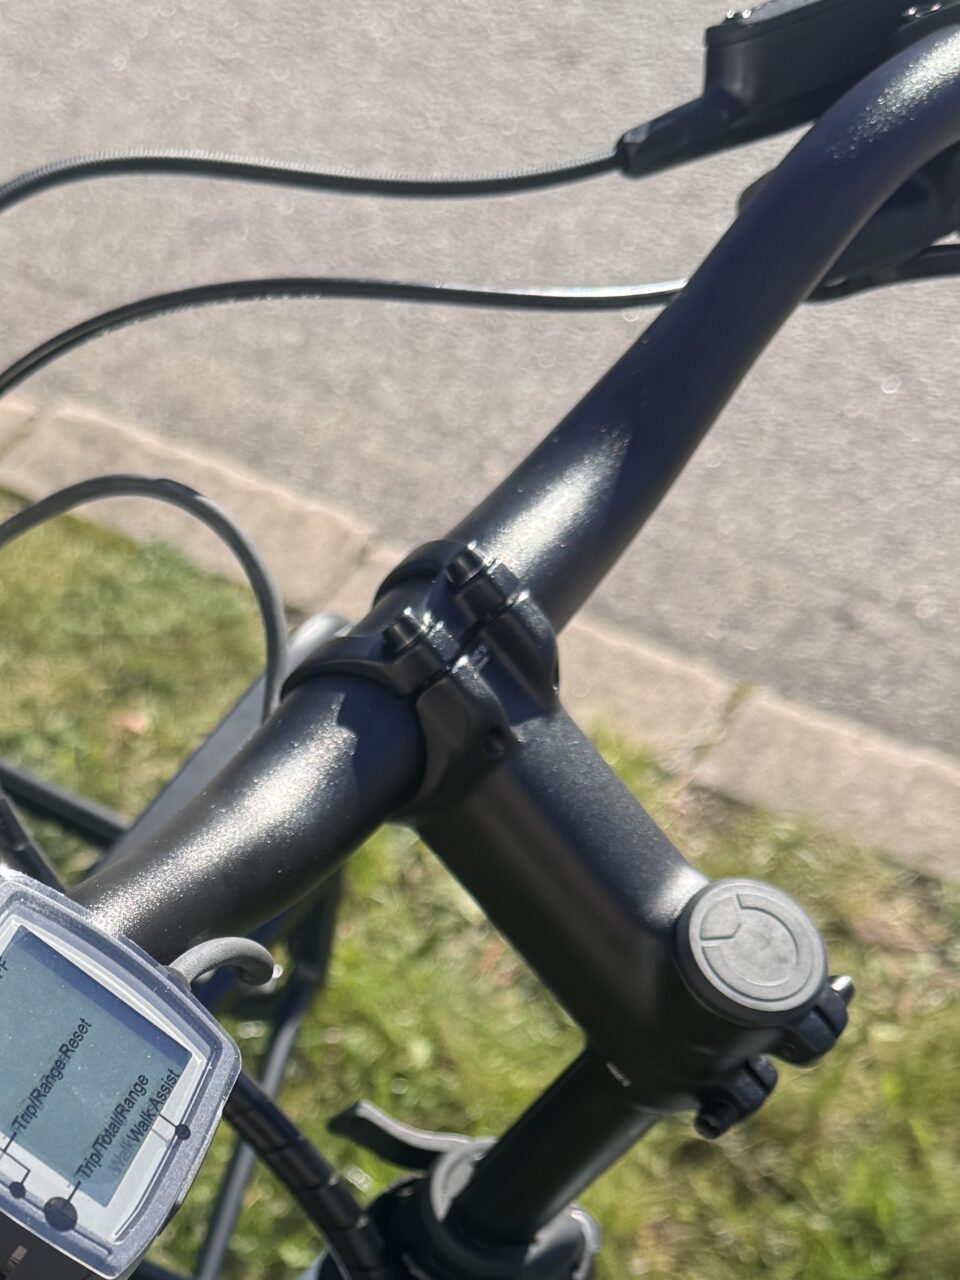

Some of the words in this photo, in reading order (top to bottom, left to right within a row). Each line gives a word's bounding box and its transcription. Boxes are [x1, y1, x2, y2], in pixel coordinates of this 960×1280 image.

[75, 1074, 149, 1179] Trip/Total/Range
[126, 1108, 157, 1144] Walk
[149, 1068, 180, 1114] Assist
